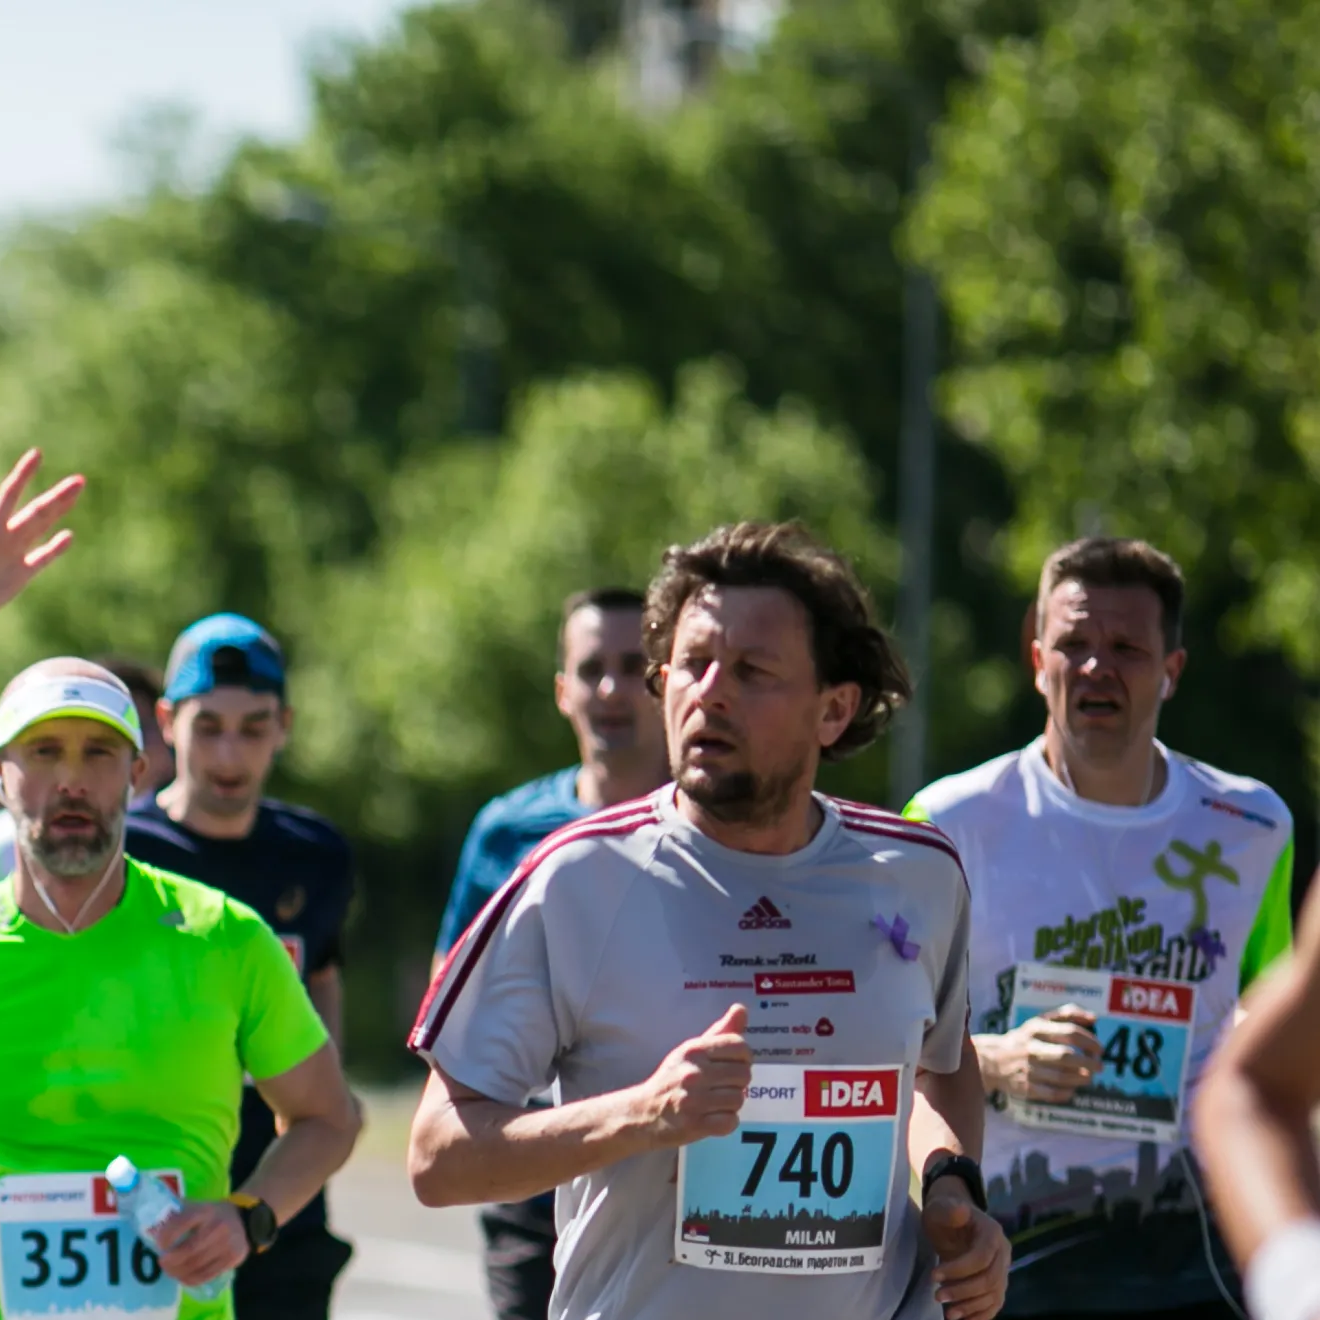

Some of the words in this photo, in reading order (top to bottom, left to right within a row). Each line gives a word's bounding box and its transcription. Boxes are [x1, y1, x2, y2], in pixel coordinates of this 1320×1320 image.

[774, 977, 824, 988] Santander
[821, 1080, 885, 1108] iDEA
[740, 1130, 855, 1200] 740
[785, 1229, 837, 1246] MILAN
[20, 1228, 161, 1289] 3516
